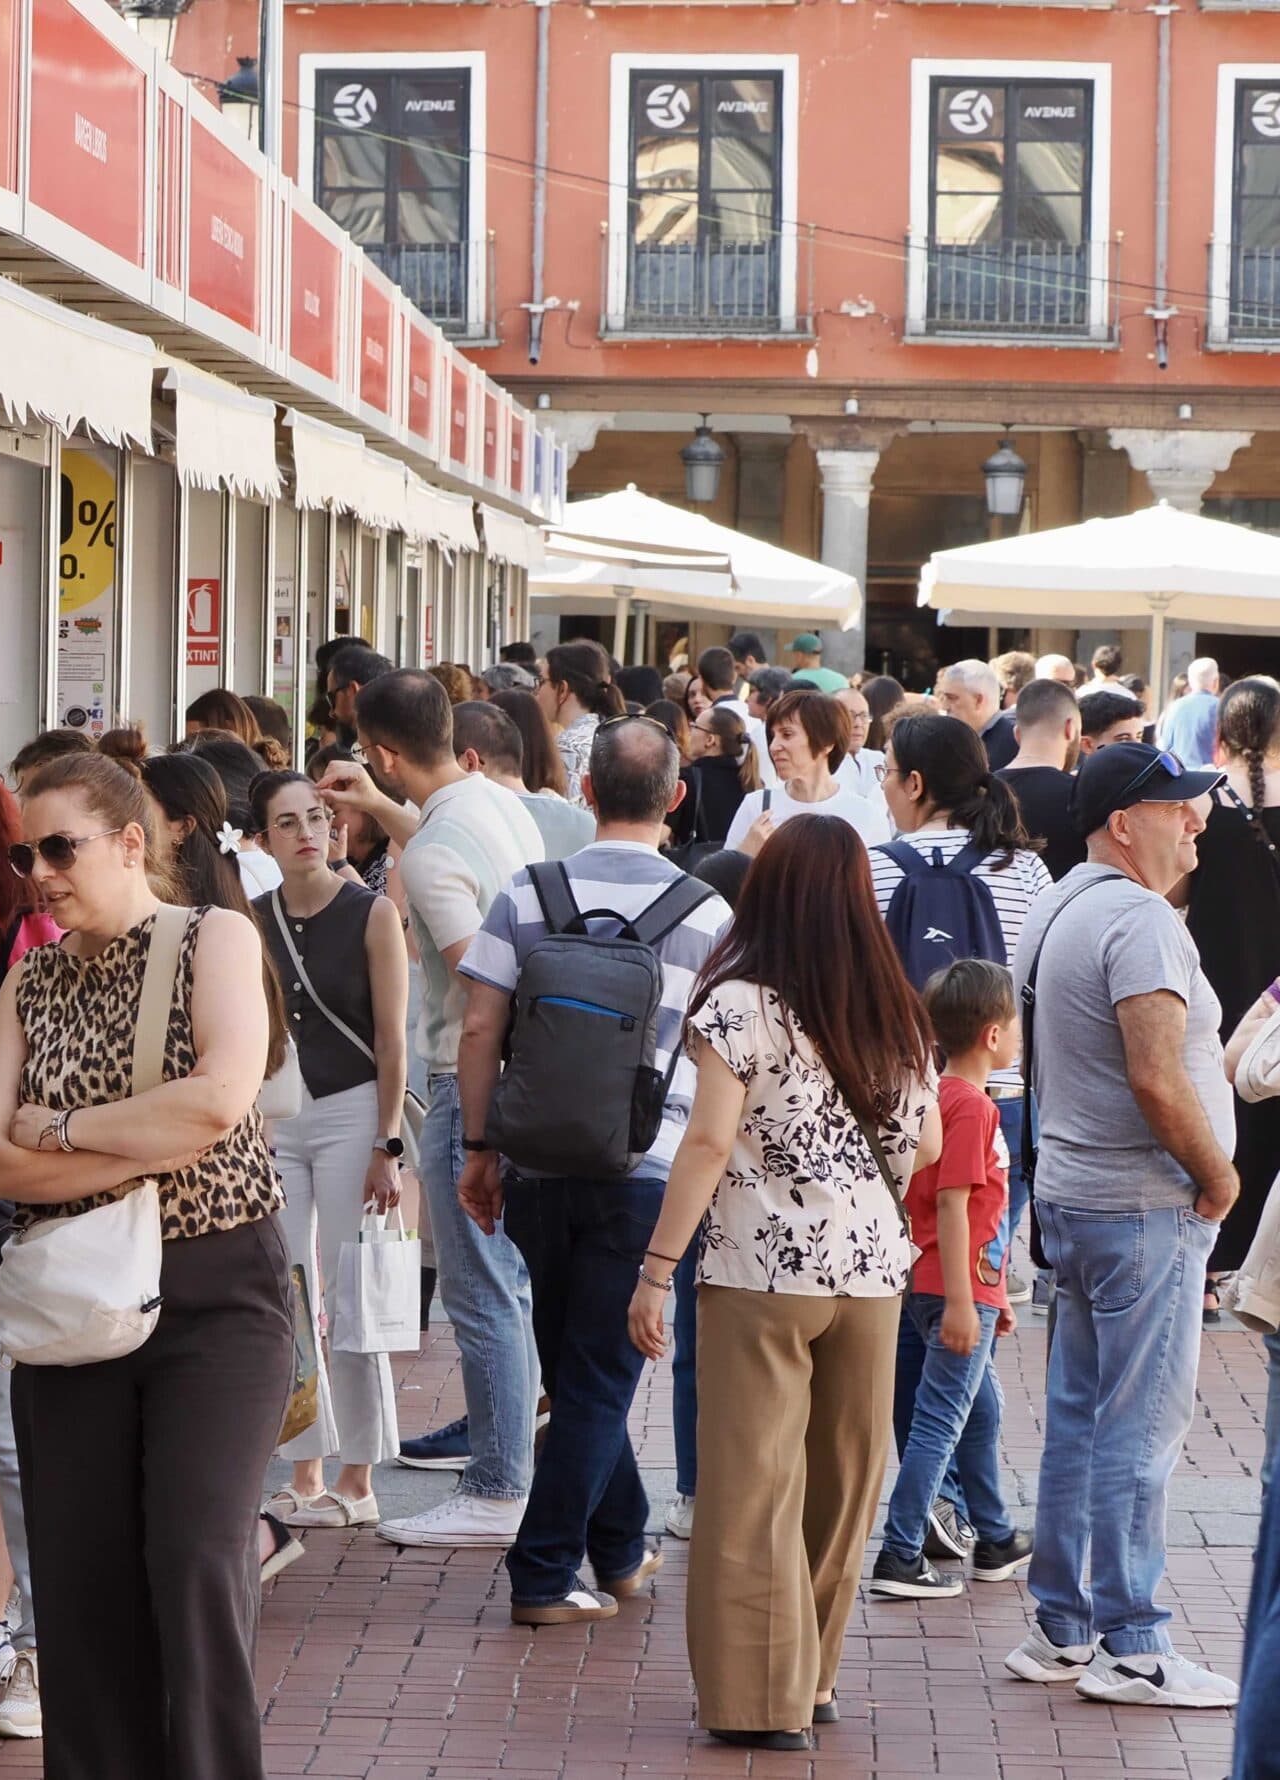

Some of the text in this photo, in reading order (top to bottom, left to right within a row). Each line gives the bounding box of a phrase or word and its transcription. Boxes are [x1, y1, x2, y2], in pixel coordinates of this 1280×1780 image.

[405, 99, 456, 112] AVENUE
[717, 101, 769, 113] AVENUE
[1024, 106, 1077, 118] AVENUE
[186, 649, 218, 662] XTINT
